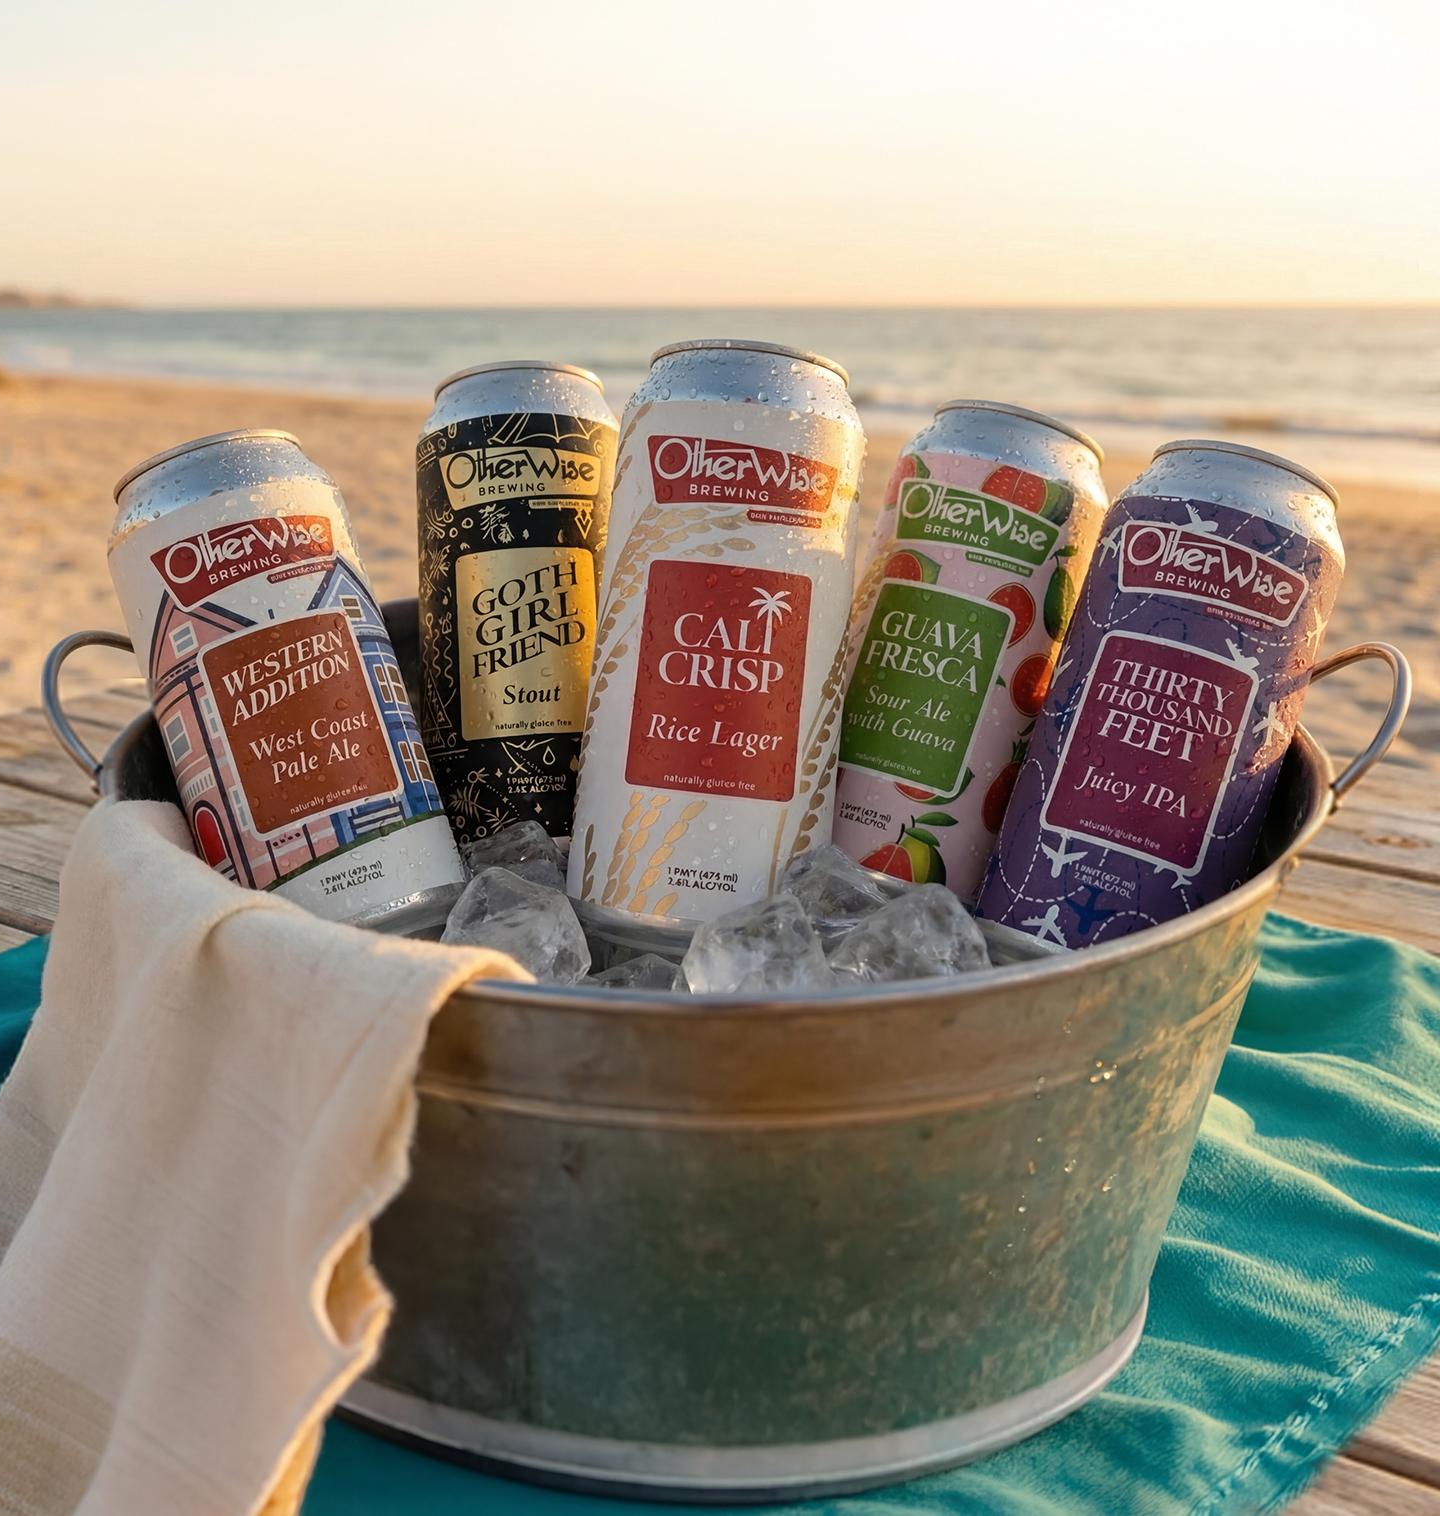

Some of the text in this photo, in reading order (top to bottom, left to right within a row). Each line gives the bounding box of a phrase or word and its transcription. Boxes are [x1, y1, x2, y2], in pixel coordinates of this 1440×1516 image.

[446, 448, 594, 489] OtherWise
[478, 482, 546, 496] BREWING
[654, 437, 829, 496] OtherWise
[689, 484, 769, 501] BREWING
[901, 483, 1048, 550] OtherWise
[164, 517, 328, 584] OtherWise
[923, 523, 990, 547] BREWING
[209, 553, 282, 585] BREWING
[472, 561, 578, 616] GOTH
[1127, 526, 1294, 605] OtherWise
[1154, 571, 1231, 599] BREWING
[475, 591, 579, 646] GIRL
[674, 596, 784, 655] CALI
[881, 610, 983, 660] GUAVA
[222, 629, 344, 697] WESTERN
[472, 620, 586, 679] FRIEND
[658, 650, 784, 694] CRISP
[865, 639, 978, 693] FRESCA
[232, 651, 350, 727] ADDITION
[503, 684, 561, 705] Stout
[865, 685, 951, 722] Sour Ale
[1096, 682, 1233, 737] THOUSAND
[1112, 658, 1235, 713] THIRTY
[249, 711, 369, 761] West Coast
[495, 720, 529, 731] naturally
[646, 713, 783, 757] Rice Lager
[847, 710, 956, 752] with Guava
[1097, 708, 1204, 762] FEET
[271, 738, 361, 785] Pale Ale
[663, 774, 704, 787] naturally
[290, 795, 325, 815] naturally
[1074, 765, 1186, 818] Juicy IPA
[1079, 818, 1114, 836] naturally
